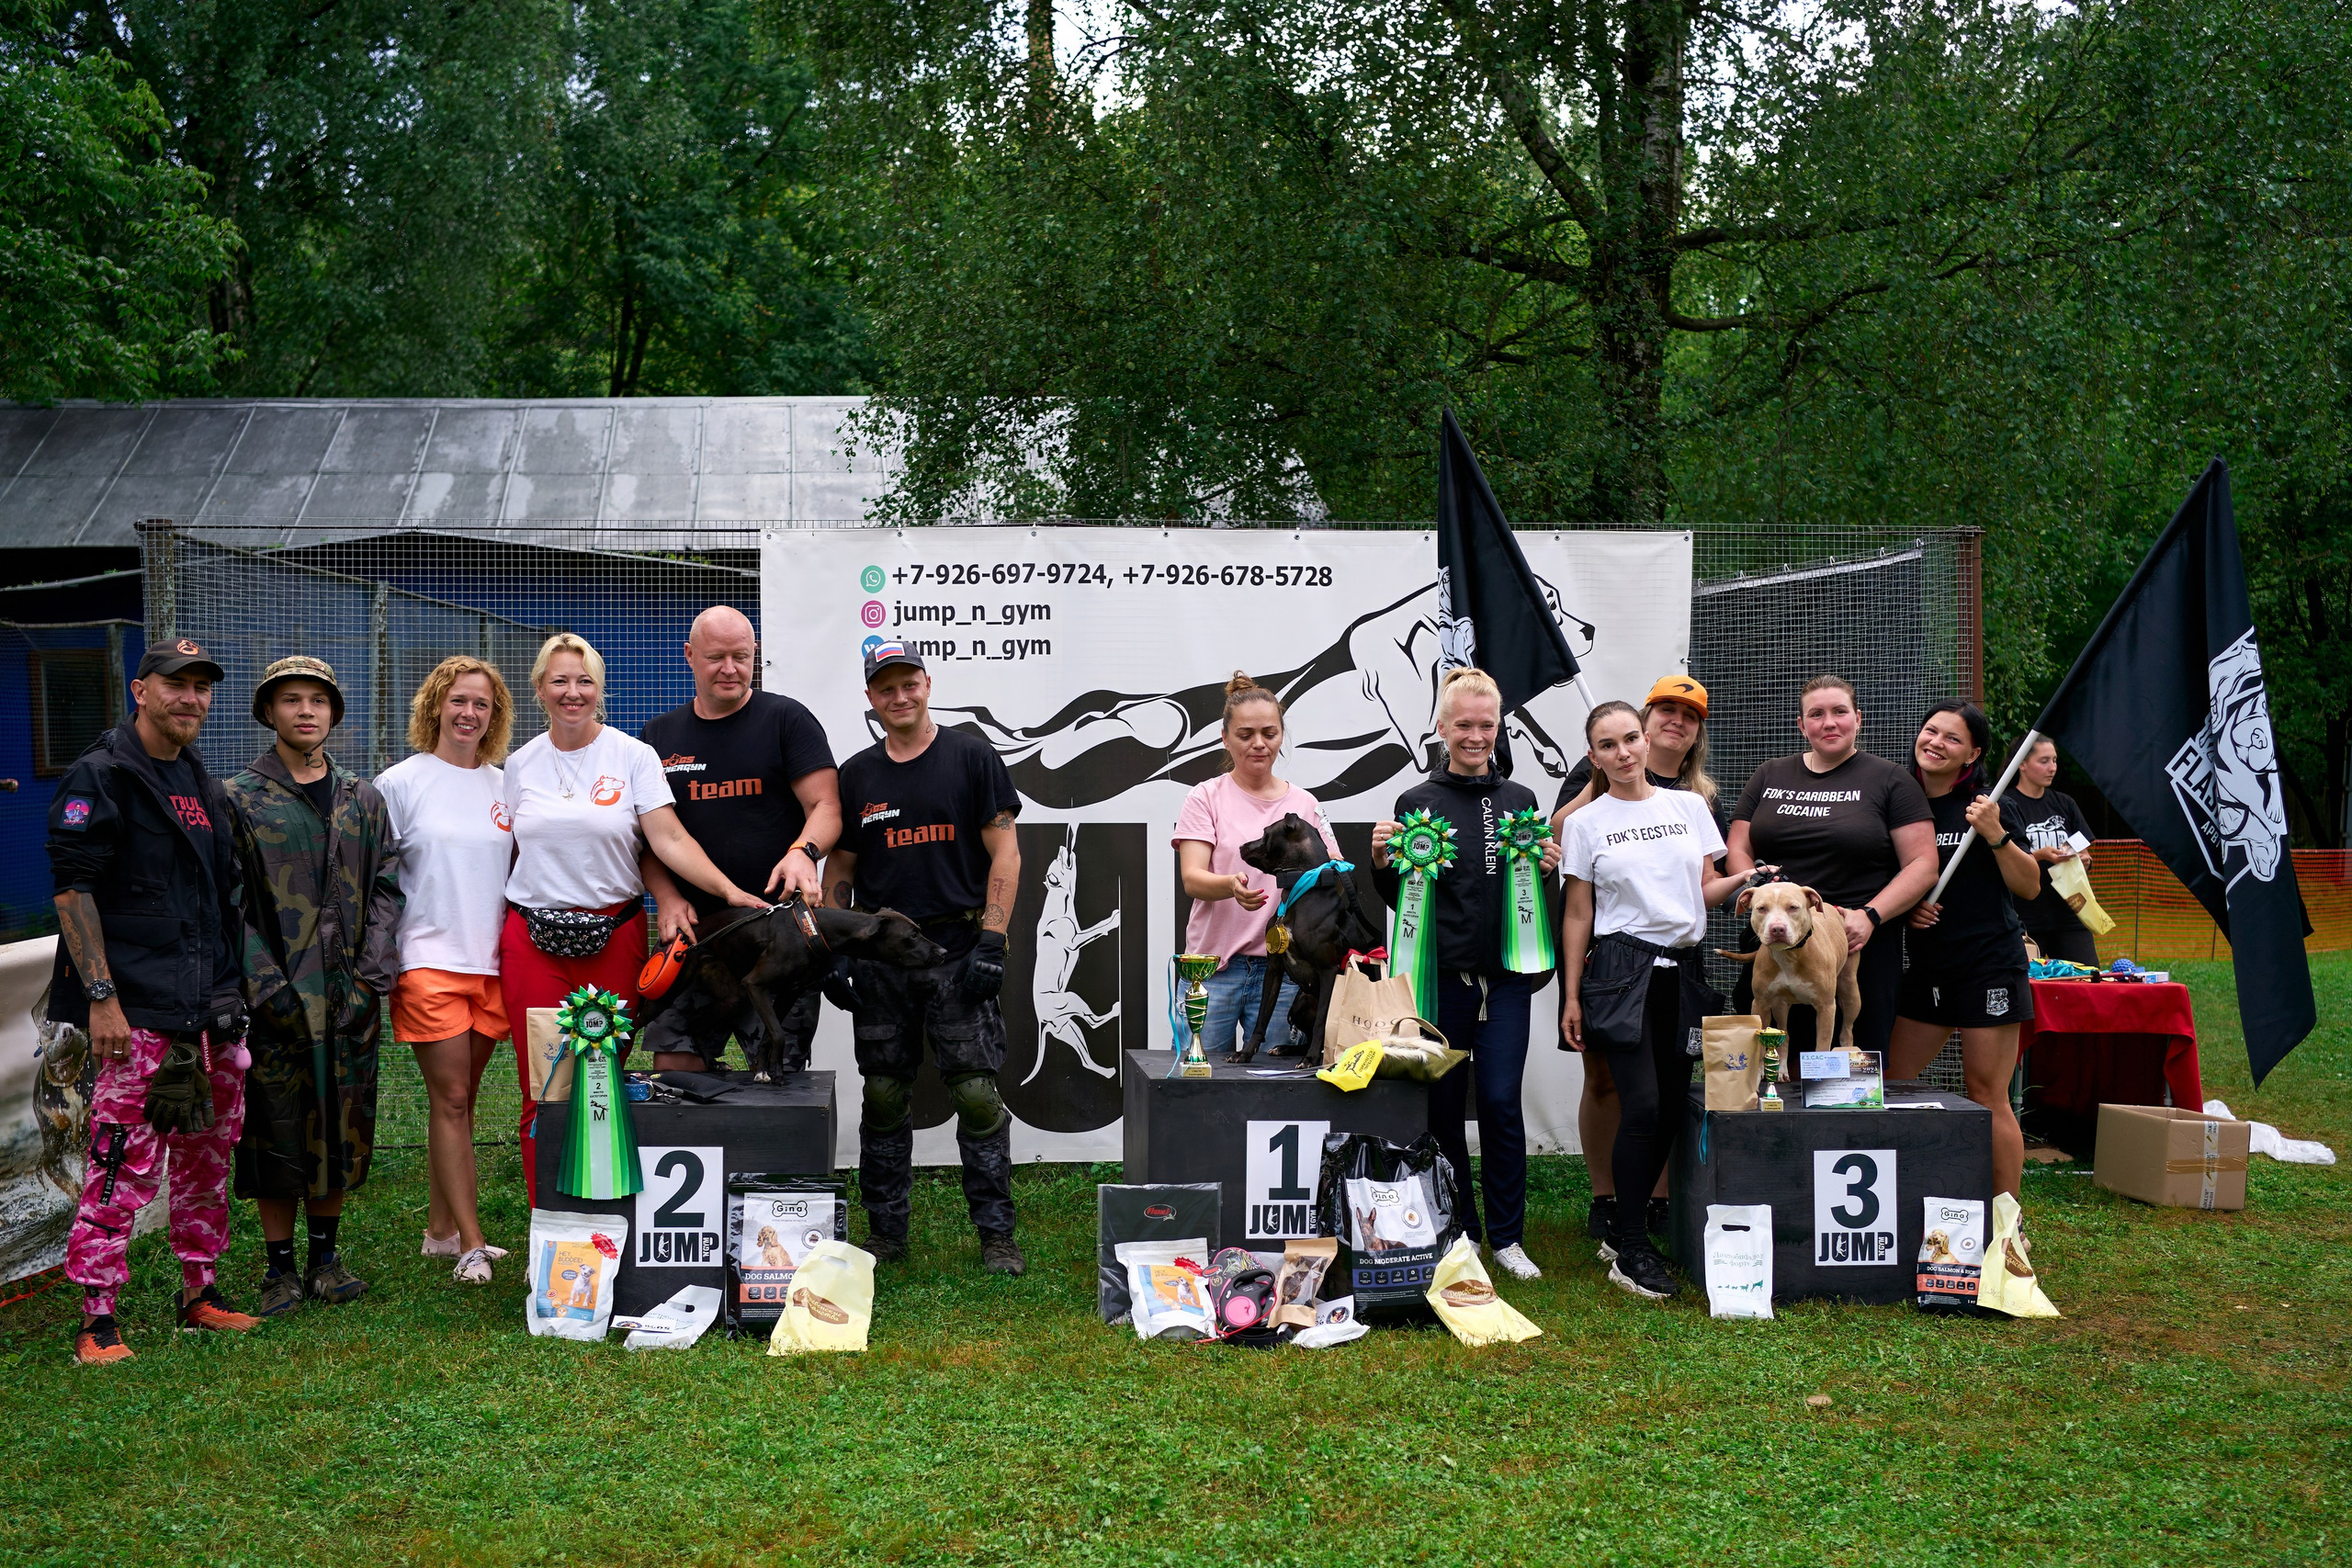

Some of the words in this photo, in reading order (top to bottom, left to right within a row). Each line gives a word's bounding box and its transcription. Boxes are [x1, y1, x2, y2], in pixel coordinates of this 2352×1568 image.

[892, 563, 1114, 589] +7-926-697-9724,
[1123, 564, 1333, 586] +7-926-678-5728
[892, 601, 1051, 626] jump_n_gym
[896, 636, 1051, 660] mp_n_gym
[664, 763, 707, 773] NERGYM
[687, 778, 763, 801] team
[1763, 787, 1795, 800] FDK'S
[1795, 790, 1860, 802] CARIBBEAN
[1481, 797, 1495, 839] CALVIN
[1776, 804, 1831, 817] COCAINE
[884, 824, 955, 848] team
[1606, 829, 1639, 846] FDK'S
[1640, 823, 1688, 840] ECSTASY
[1485, 841, 1497, 874] KLEIN
[1521, 914, 1531, 924] M
[1403, 927, 1414, 938] M
[594, 1110, 605, 1121] M
[1269, 1124, 1310, 1200] 1
[654, 1150, 705, 1227] 2
[1830, 1153, 1880, 1229] 3
[639, 1232, 719, 1262] JUMP
[1374, 1256, 1410, 1265] MODERATE
[1411, 1252, 1433, 1261] ACTIVE
[1818, 1232, 1894, 1262] JUMP
